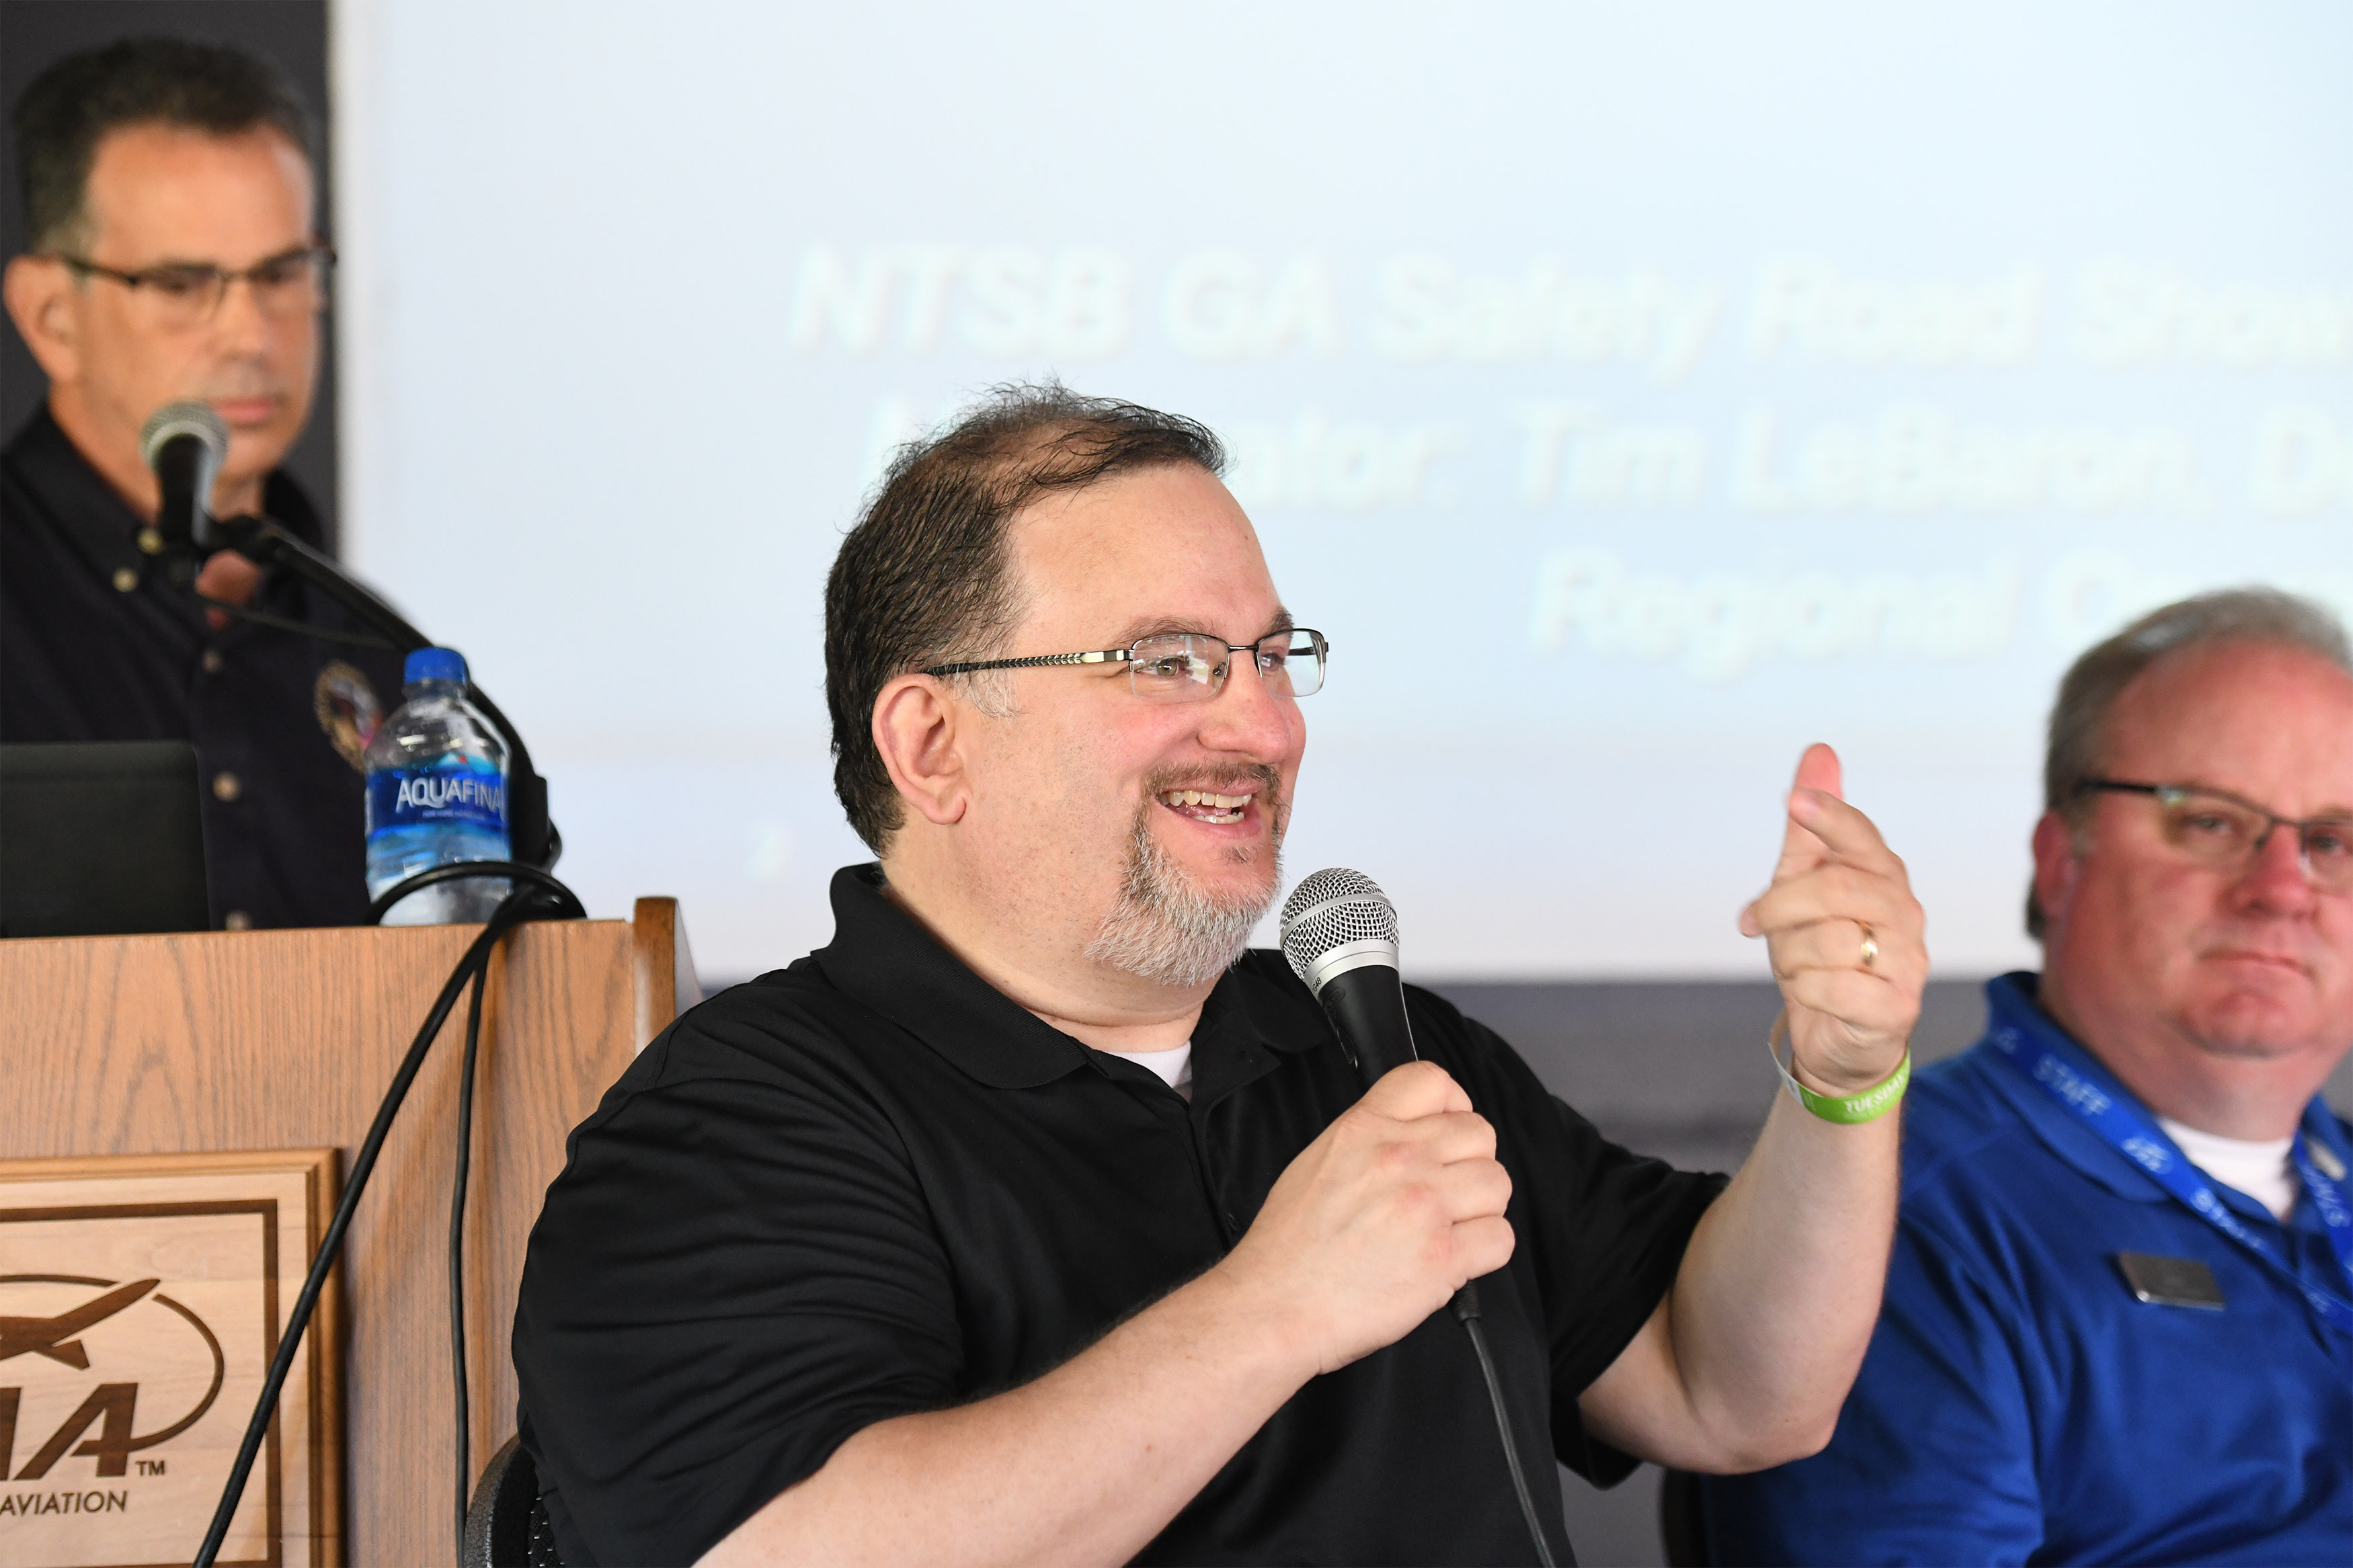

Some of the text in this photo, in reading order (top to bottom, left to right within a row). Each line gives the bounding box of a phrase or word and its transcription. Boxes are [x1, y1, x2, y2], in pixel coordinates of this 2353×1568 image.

[792, 243, 1131, 355] NTSB
[1167, 249, 1342, 358] GA
[1374, 251, 1724, 386] Safety
[1752, 253, 2044, 364] Road
[1518, 399, 1708, 508] Tim
[2258, 402, 2353, 511] D
[1533, 548, 2022, 682] Regional
[395, 777, 504, 822] AQUAFINA
[0, 1490, 128, 1516] AVIATION
[135, 1460, 165, 1477] TM
